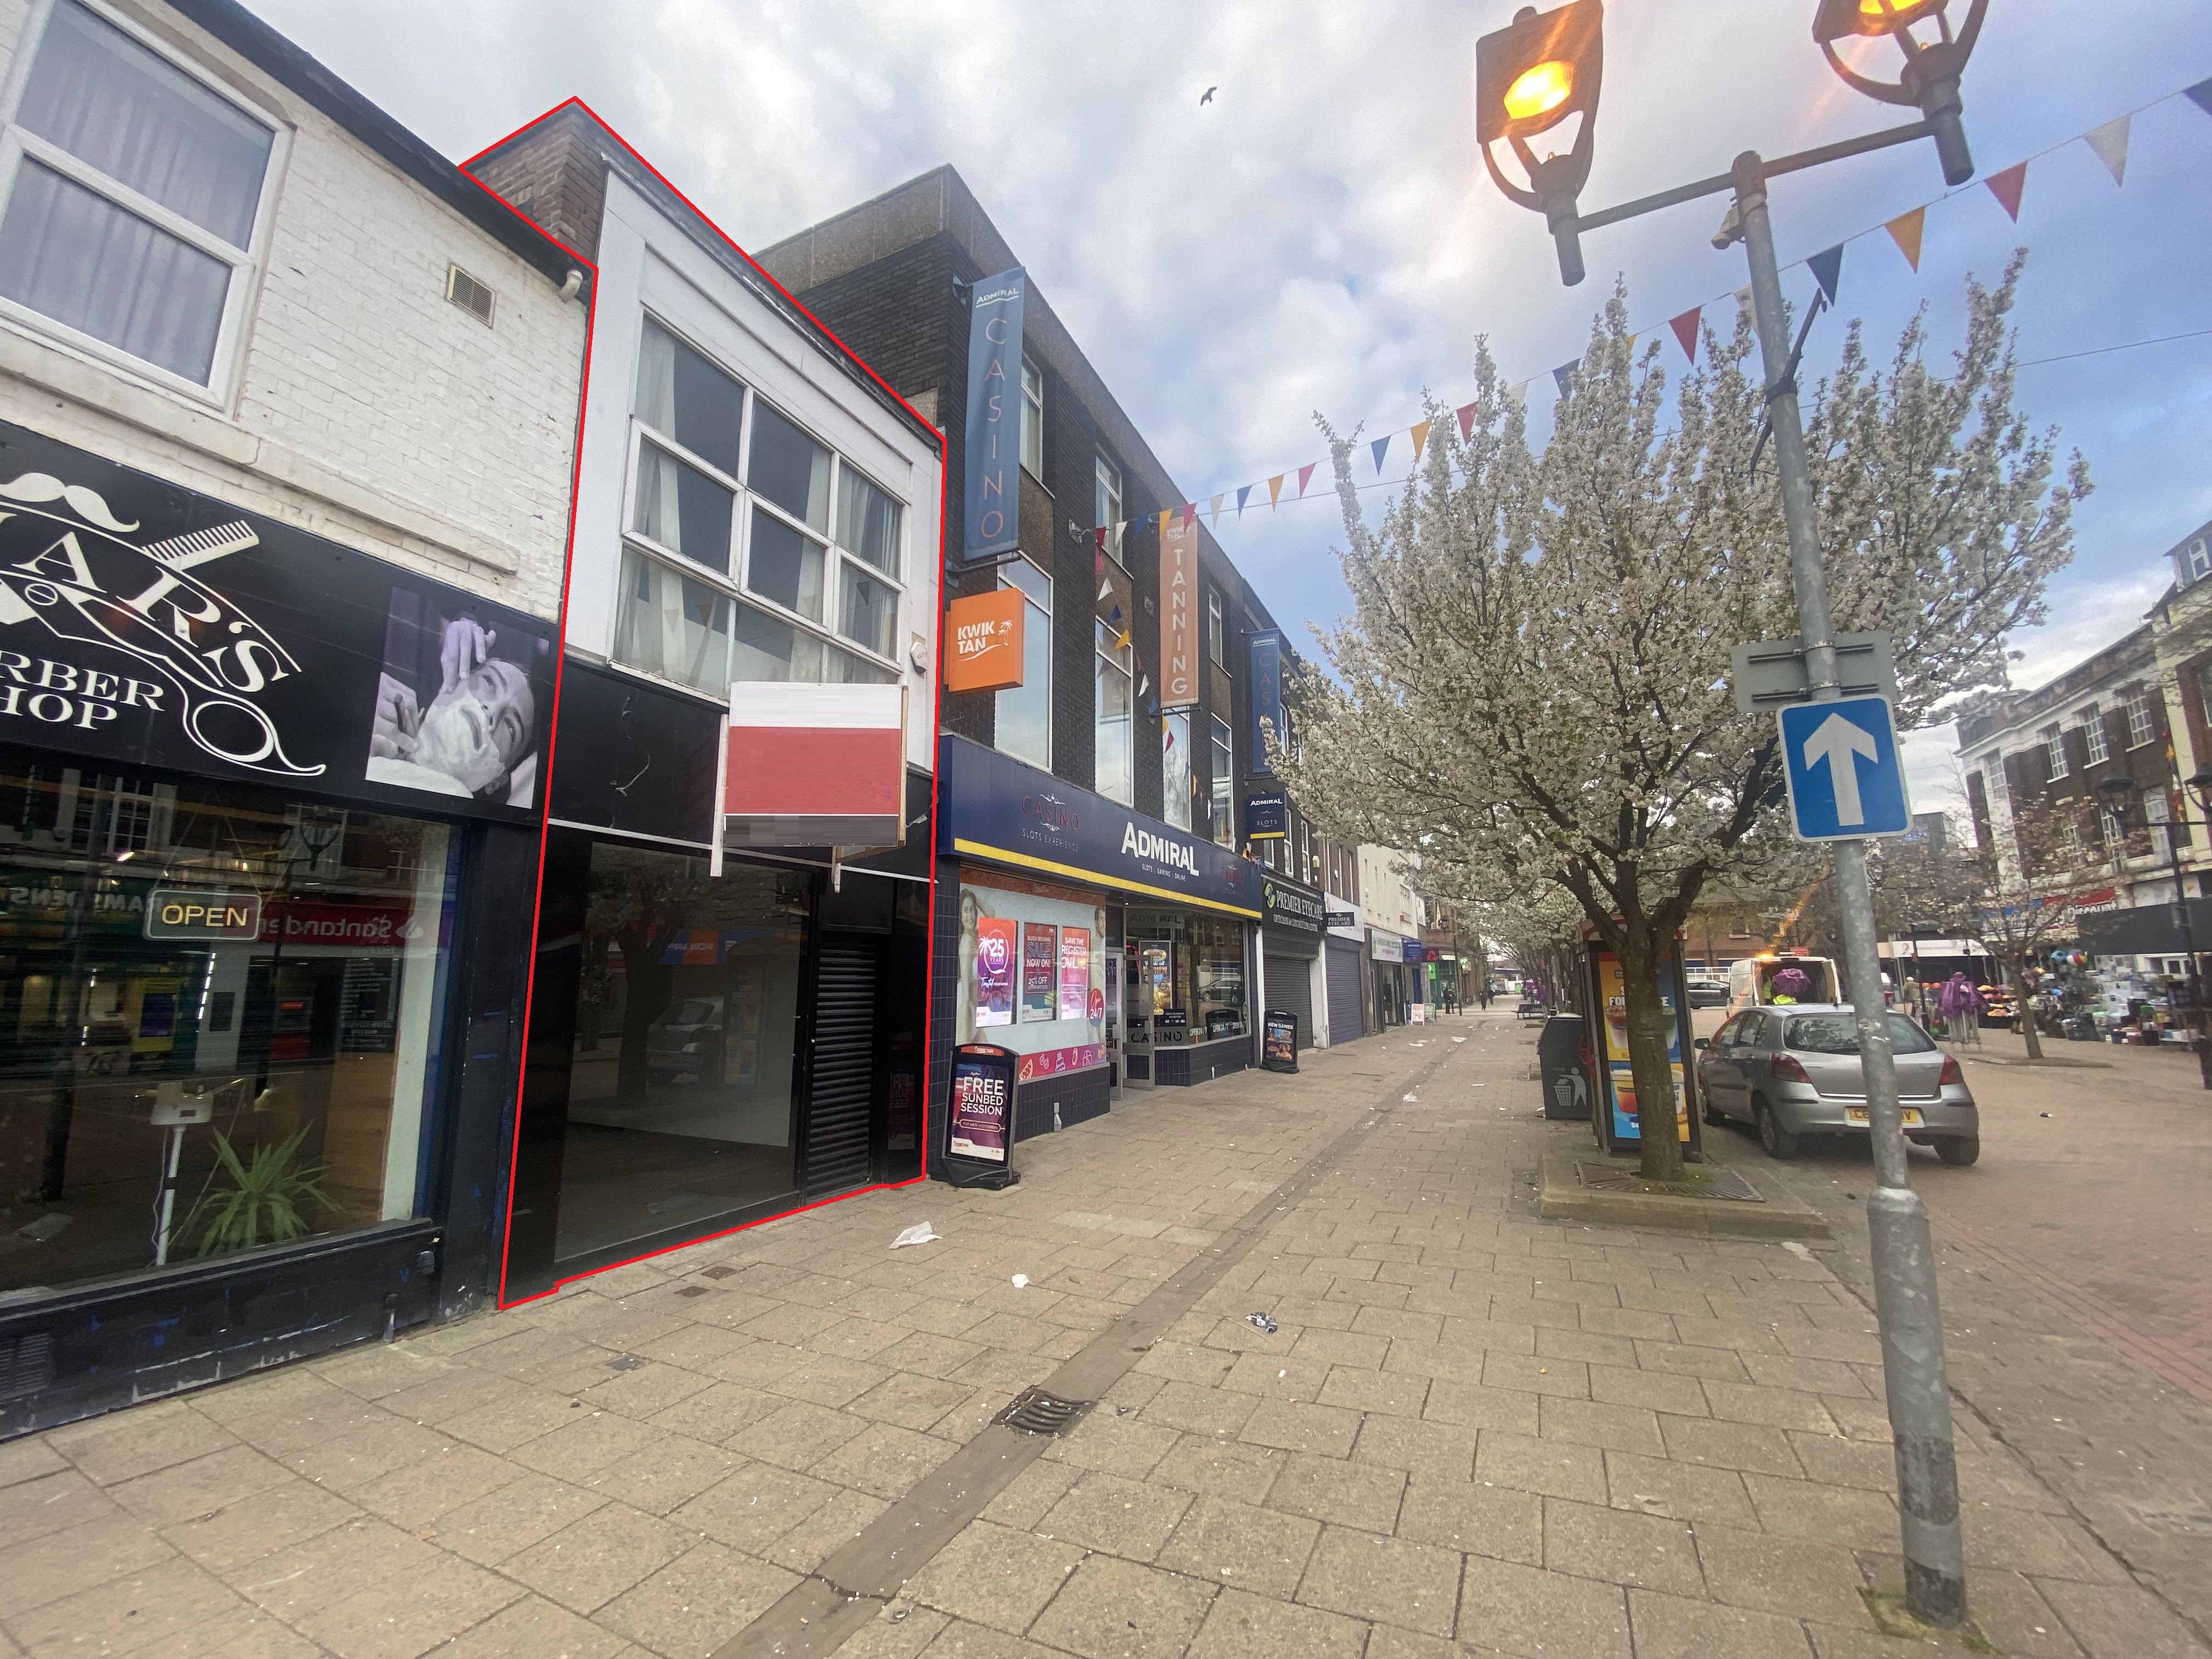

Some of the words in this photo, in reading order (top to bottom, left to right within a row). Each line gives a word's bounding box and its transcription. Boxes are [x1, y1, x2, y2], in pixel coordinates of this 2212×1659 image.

[976, 287, 1019, 305] ADMIRAL
[980, 318, 1008, 539] CASINO
[1166, 526, 1183, 534] KWIK
[0, 511, 289, 693] AR'S
[958, 620, 995, 641] KWIK
[1171, 549, 1188, 695] TANNING
[957, 636, 986, 654] TAN
[1250, 798, 1283, 806] ADMIRAL
[1022, 795, 1079, 831] CASINO
[1023, 828, 1042, 842] SLOTS
[1121, 821, 1199, 877] ADMIRAL
[1141, 863, 1153, 873] SLOTS
[1156, 867, 1171, 878] GAMING
[1276, 890, 1302, 915] PREMIER
[1301, 899, 1324, 920] EYECARE
[161, 905, 248, 927] OPEN
[1128, 913, 1182, 924] ADMIRAL
[989, 938, 1005, 957] 25
[1027, 941, 1051, 958] SALE
[1062, 945, 1087, 956] REGISTER
[1026, 958, 1041, 968] NOW
[1041, 959, 1051, 968] ON!
[1038, 976, 1048, 985] OFF
[1090, 1007, 1103, 1019] 24/7
[1131, 1030, 1183, 1043] CASINO
[963, 1076, 1004, 1096] FREE
[962, 1092, 1003, 1105] SUNBED
[961, 1102, 1002, 1116] SESSION
